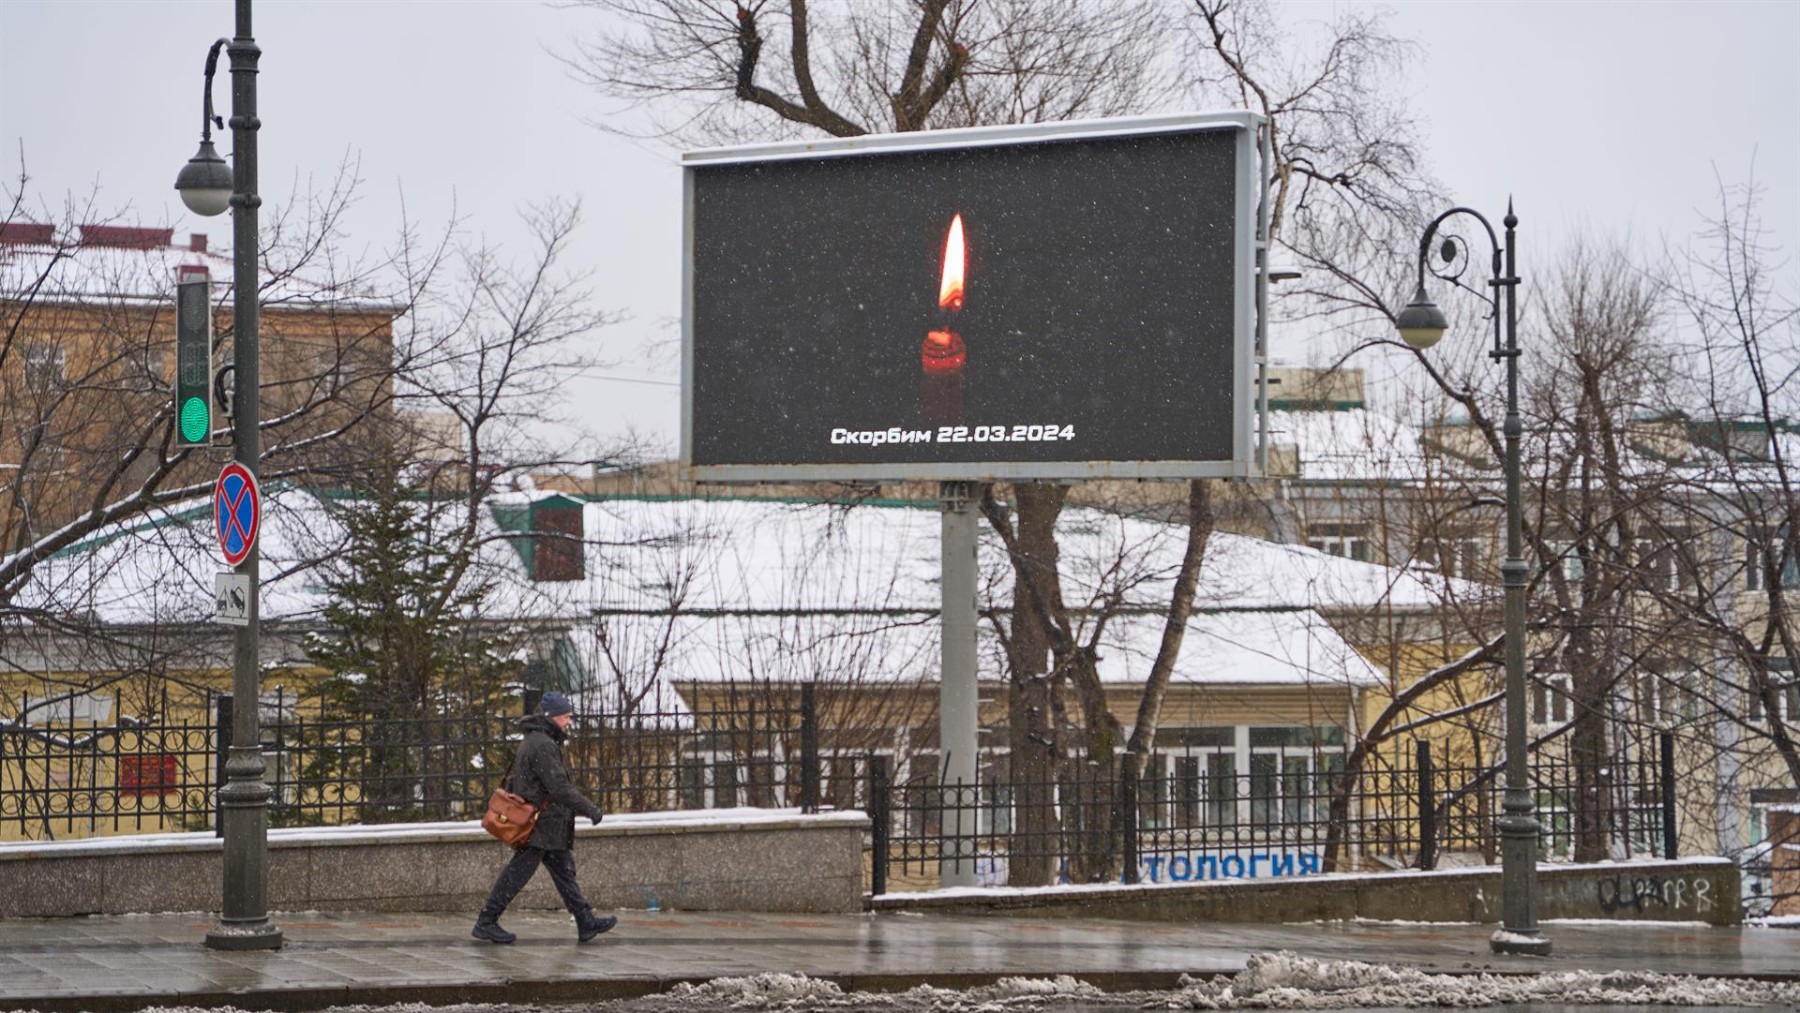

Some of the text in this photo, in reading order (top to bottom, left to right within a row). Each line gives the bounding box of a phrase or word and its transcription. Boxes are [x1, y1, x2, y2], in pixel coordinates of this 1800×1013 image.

[830, 424, 1076, 447] Скорбим 22.03.2024
[1121, 853, 1318, 884] ТОЛОГИЯ
